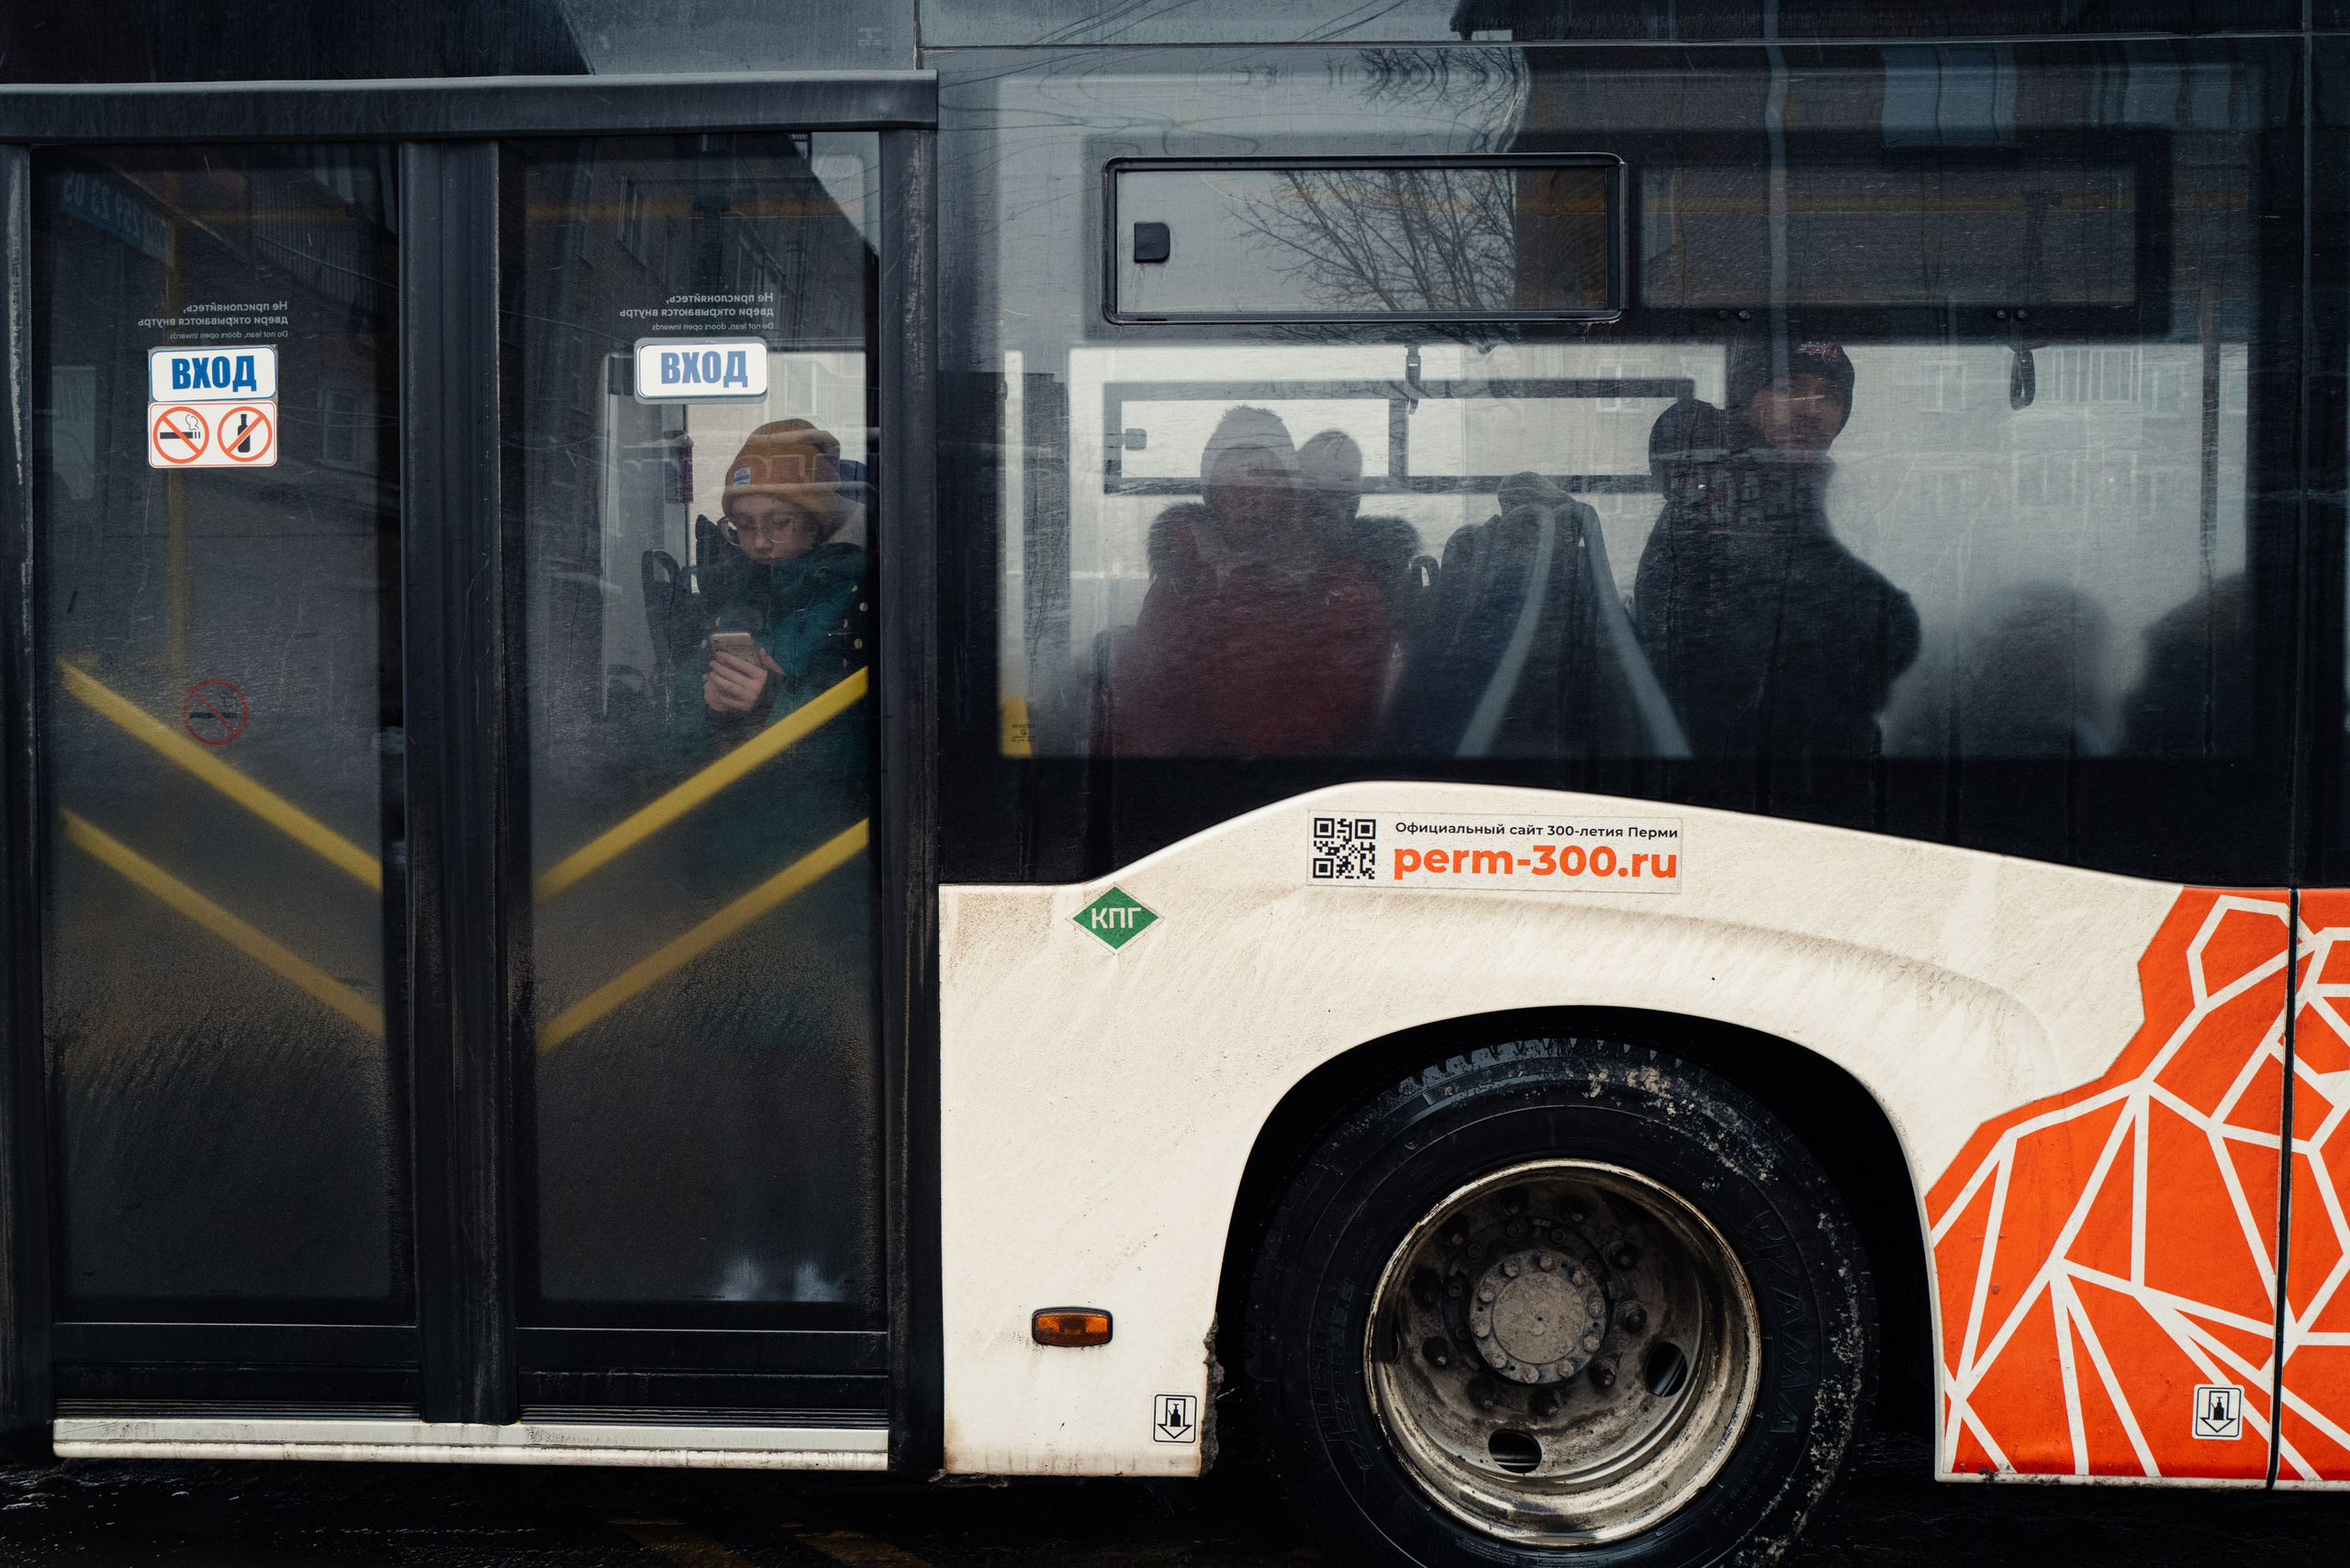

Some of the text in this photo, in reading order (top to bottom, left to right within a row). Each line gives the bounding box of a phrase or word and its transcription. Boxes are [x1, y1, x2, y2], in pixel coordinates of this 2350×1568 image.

[172, 355, 257, 393] ВХОД
[661, 351, 748, 388] ВХОД
[1395, 822, 1678, 840] Официальный сайт 300-летия Перми
[1393, 844, 1676, 880] perm-300.ru
[1091, 907, 1142, 929] КПГ
